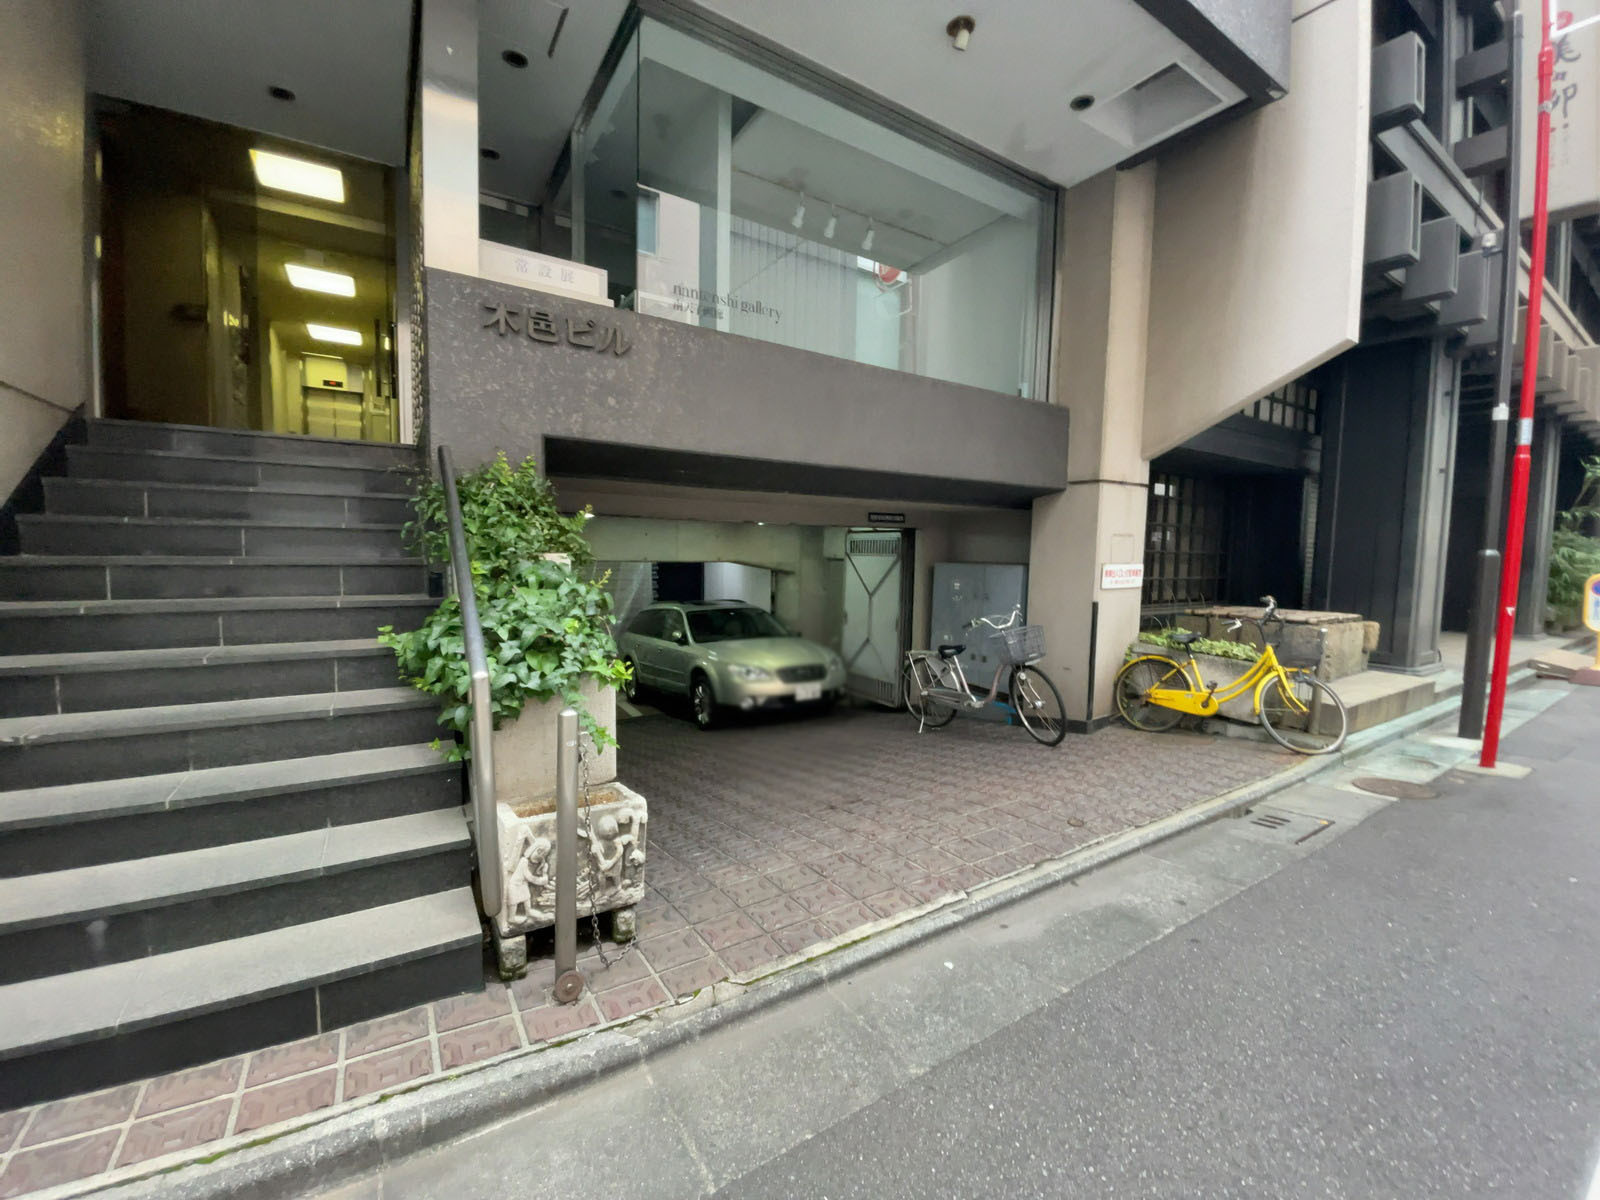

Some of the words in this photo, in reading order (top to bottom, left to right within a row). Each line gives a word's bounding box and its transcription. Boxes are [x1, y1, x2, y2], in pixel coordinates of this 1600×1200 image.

[483, 302, 632, 356] 木邑ビル
[740, 300, 783, 325] gallery
